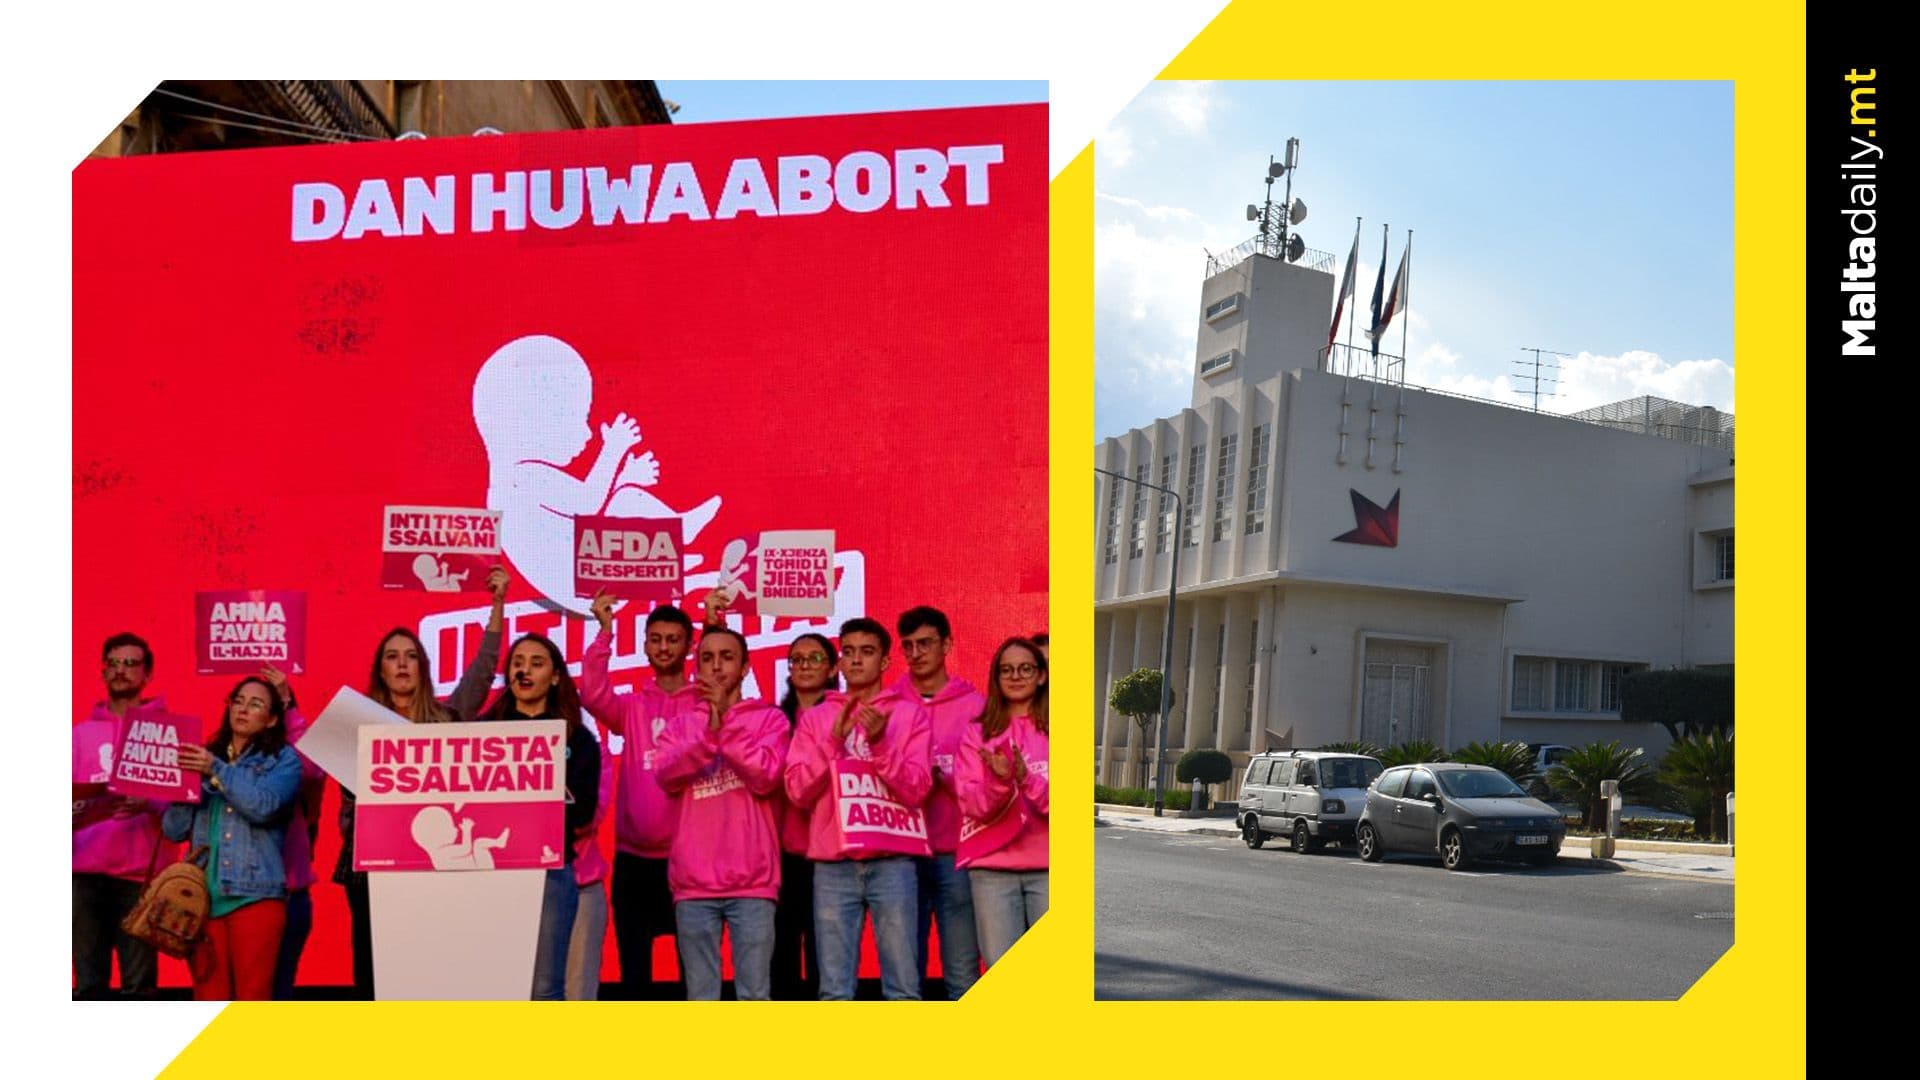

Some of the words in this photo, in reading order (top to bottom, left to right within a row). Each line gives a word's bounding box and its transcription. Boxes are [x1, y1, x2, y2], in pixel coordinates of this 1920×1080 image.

[291, 175, 456, 242] DAN
[470, 161, 716, 233] HUWA
[715, 144, 1005, 219] ABORT
[390, 513, 430, 529] INTI
[433, 514, 499, 531] TISTA'
[389, 530, 496, 548] SSALVANI
[578, 529, 678, 560] AFDA
[580, 562, 675, 577] FL-ESPERTI
[763, 571, 827, 586] JIENA
[763, 587, 827, 598] BNIEDEM
[210, 623, 286, 642] FAVUR
[122, 741, 178, 767] FAVUR
[371, 737, 442, 764] INTI
[446, 735, 560, 763] TISTA'
[370, 764, 554, 794] SSALVANI
[847, 803, 921, 833] ABORT
